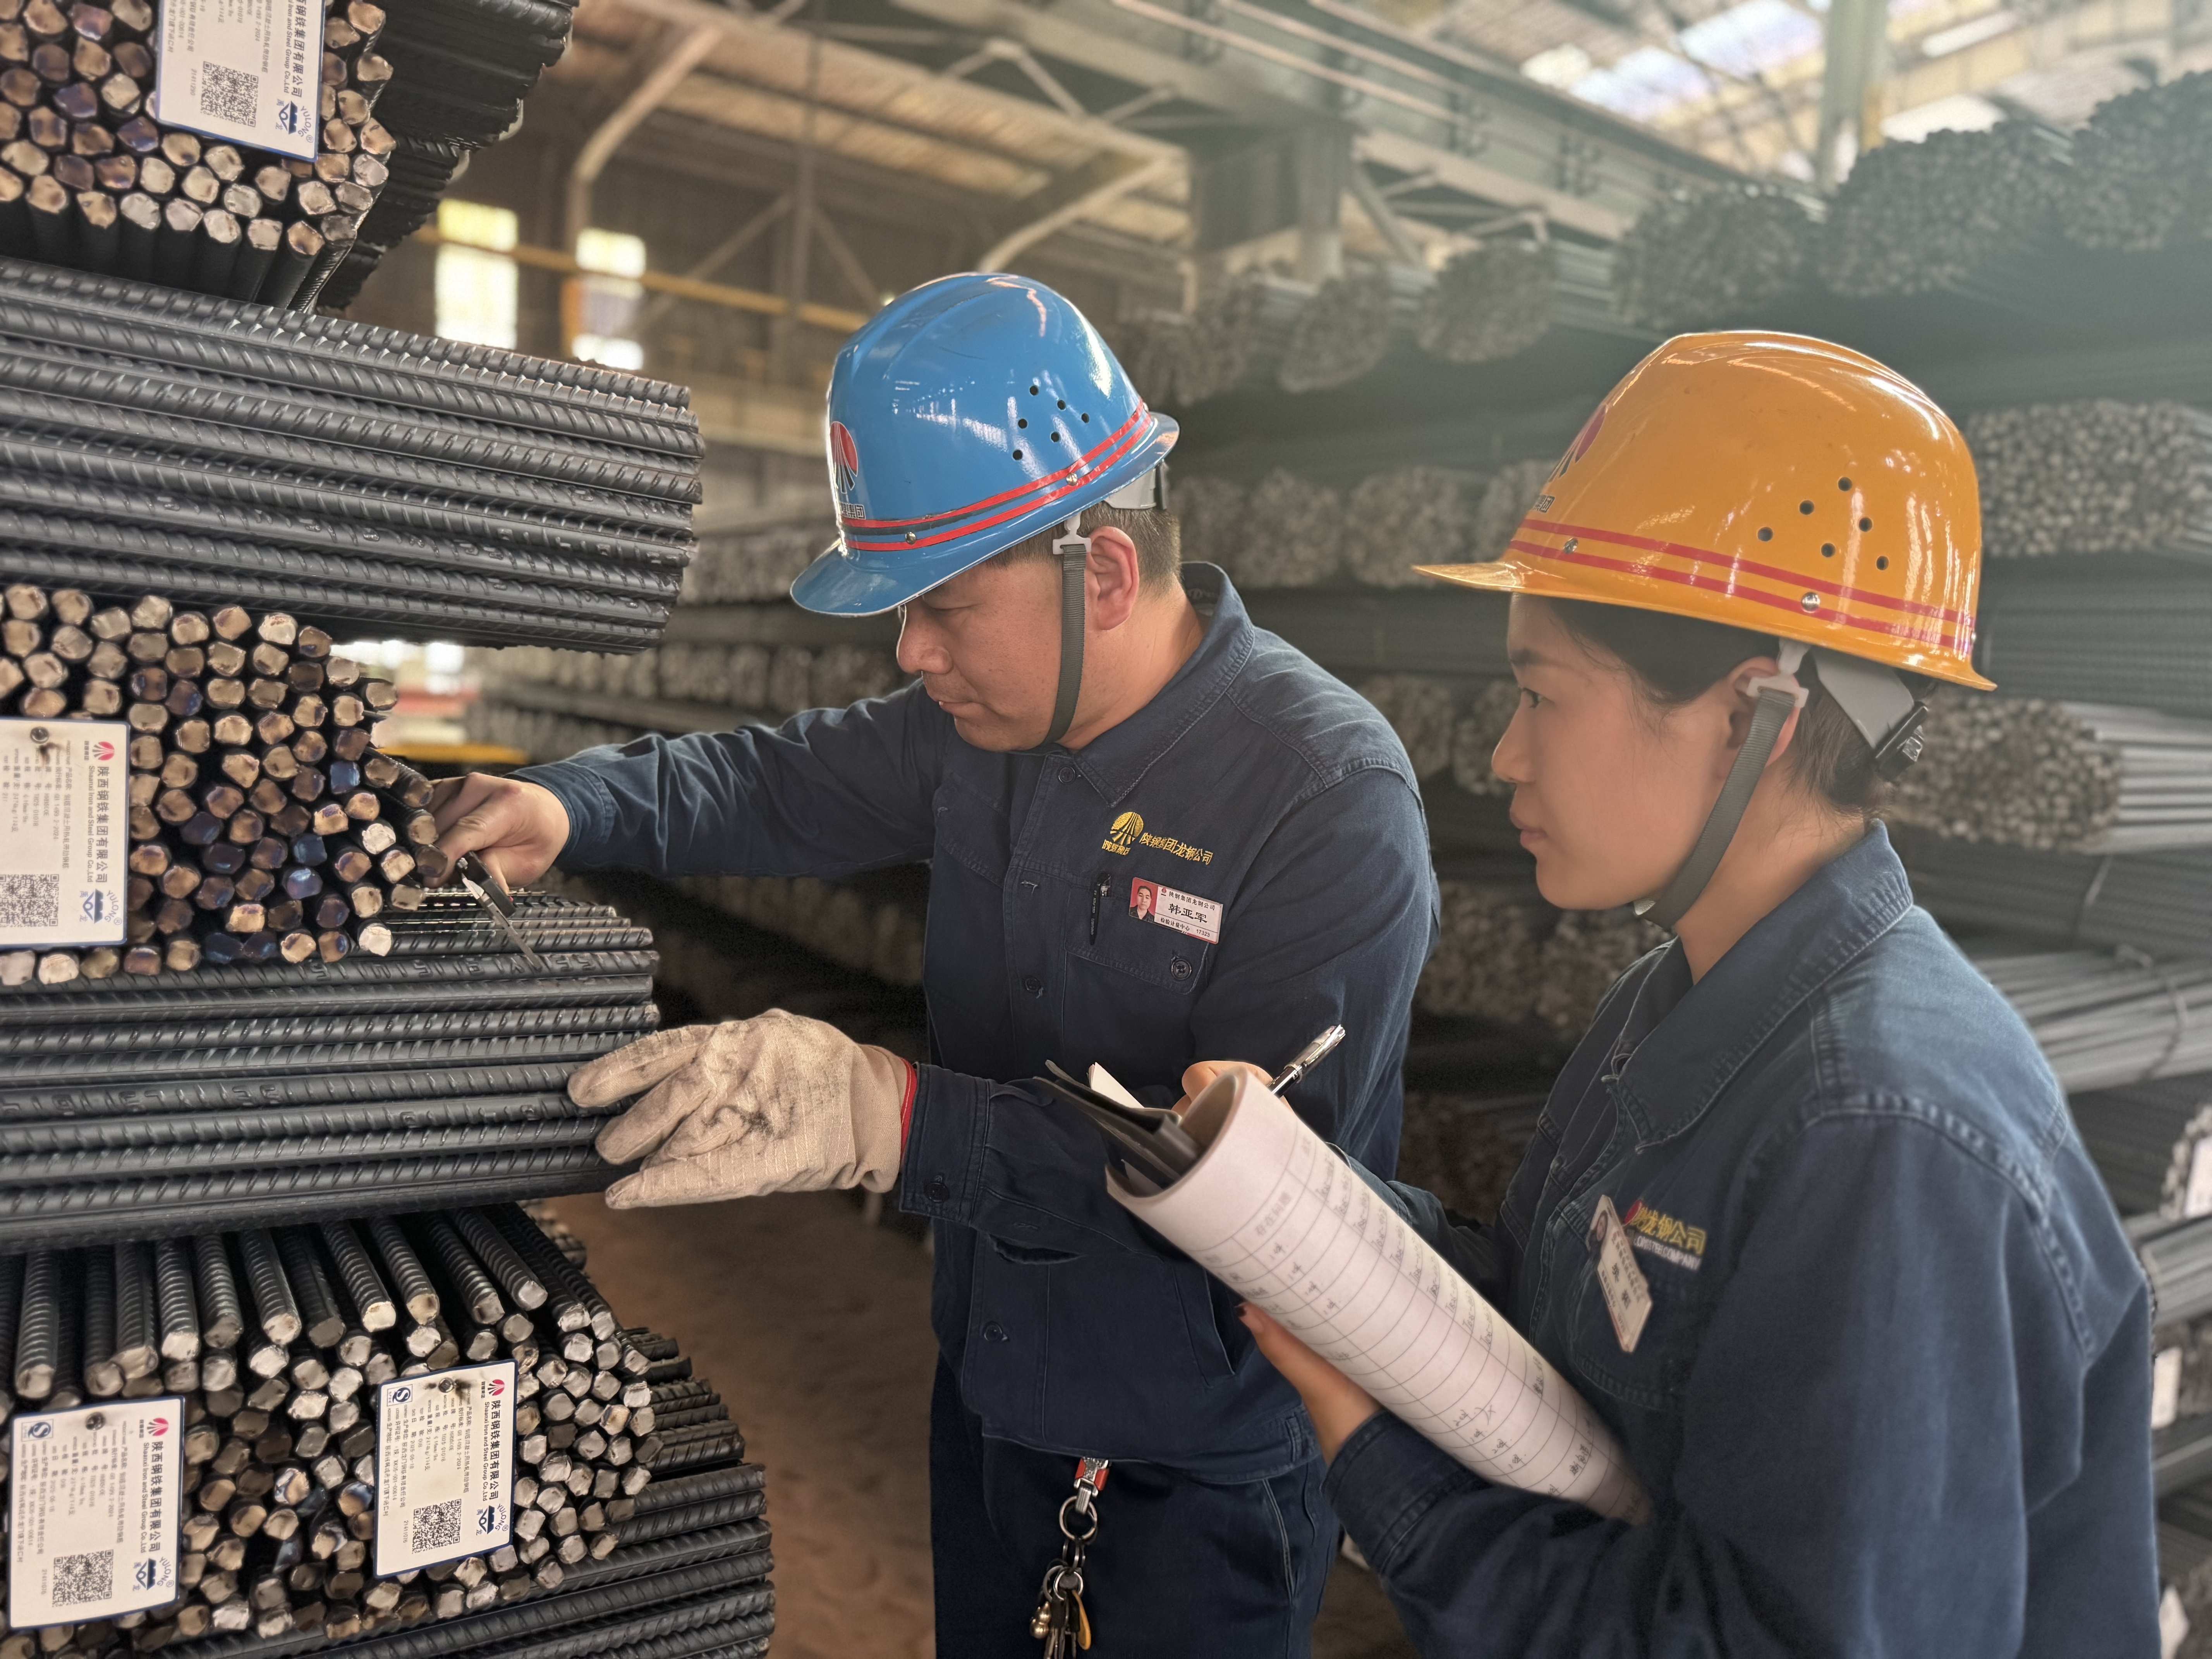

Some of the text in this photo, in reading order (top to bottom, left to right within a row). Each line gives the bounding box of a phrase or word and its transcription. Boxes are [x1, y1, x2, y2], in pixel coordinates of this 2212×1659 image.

[297, 105, 312, 139] YULONG
[96, 766, 109, 882] 陕西钢铁集团有限公司
[104, 890, 118, 922] YULONG
[1168, 891, 1215, 911] 陕钢集团龙钢公司
[1168, 903, 1208, 924] 韩亚军
[1196, 929, 1211, 938] 17323
[489, 1400, 501, 1500] 陕西钢铁集团有限公司
[149, 1441, 163, 1552] 陕西钢铁集团有限公司
[495, 1502, 507, 1531] YULONG
[156, 1555, 172, 1587] YULONG
